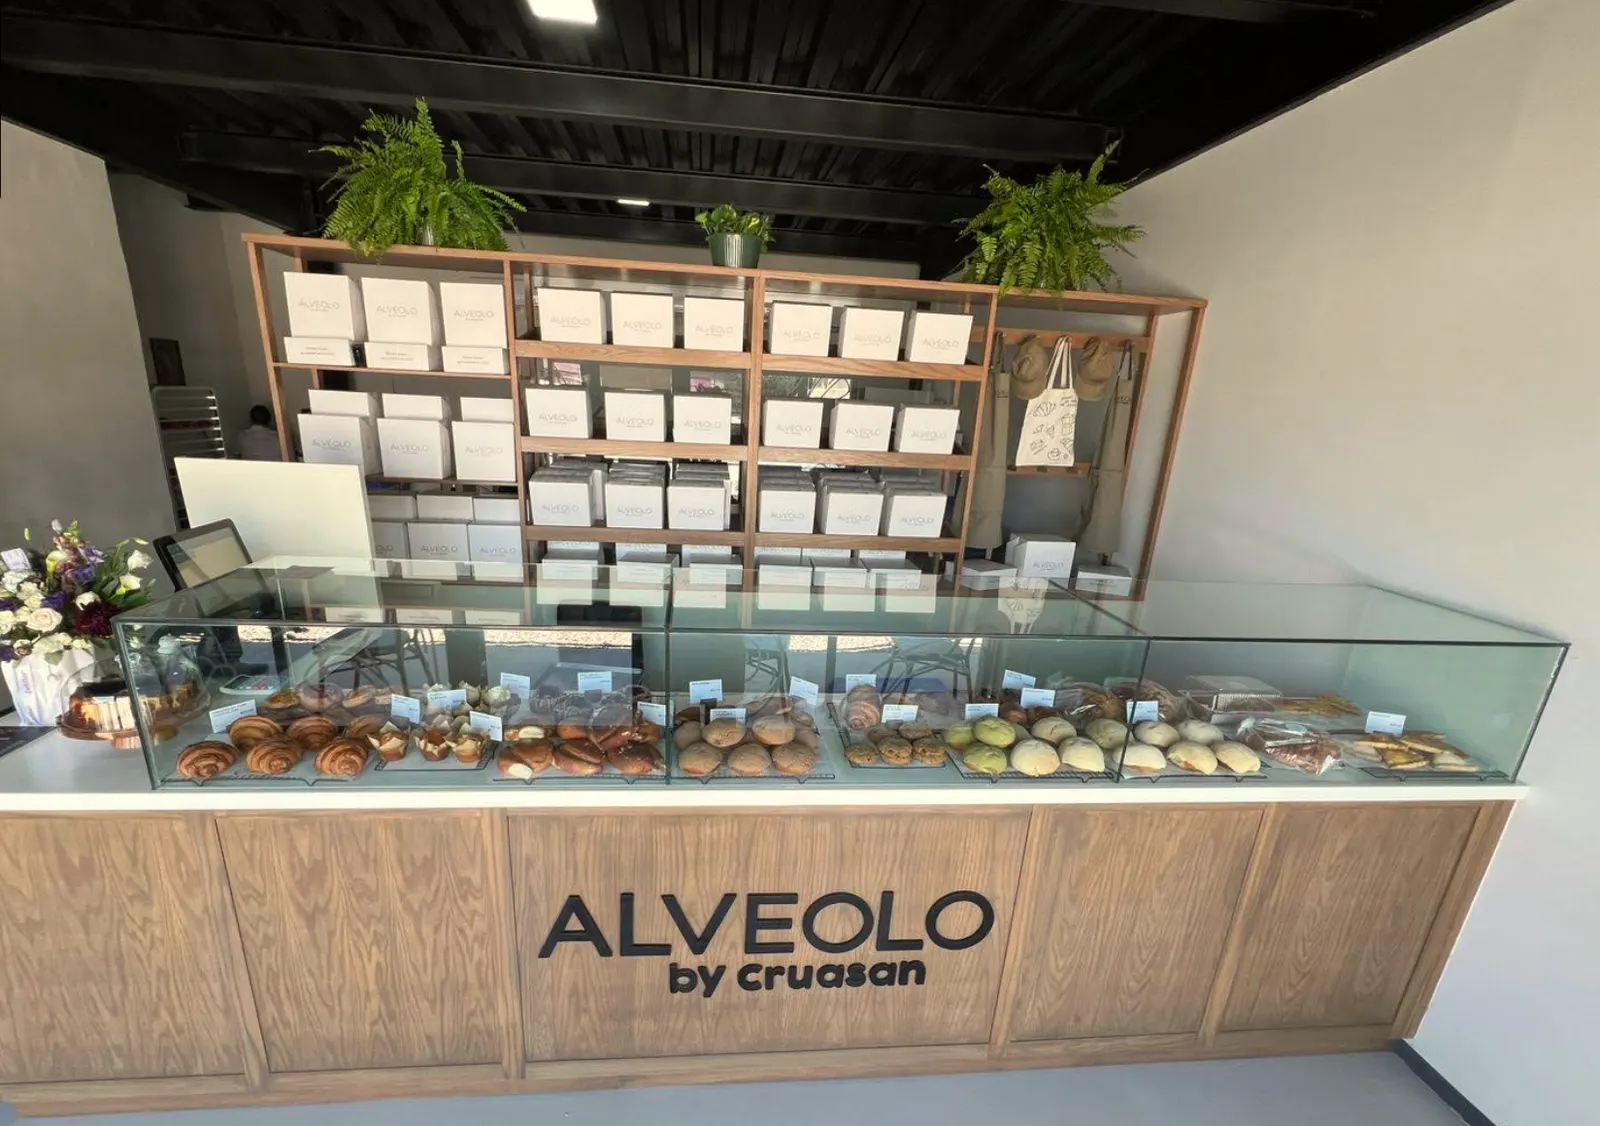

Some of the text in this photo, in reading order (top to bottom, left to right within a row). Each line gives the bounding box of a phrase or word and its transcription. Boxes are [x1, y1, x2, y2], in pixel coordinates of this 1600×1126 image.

[376, 304, 418, 316] ALVEOLO
[453, 309, 494, 319] ALVEOLO
[538, 889, 995, 958] ALVEOLO
[669, 958, 926, 998] by cruasan
